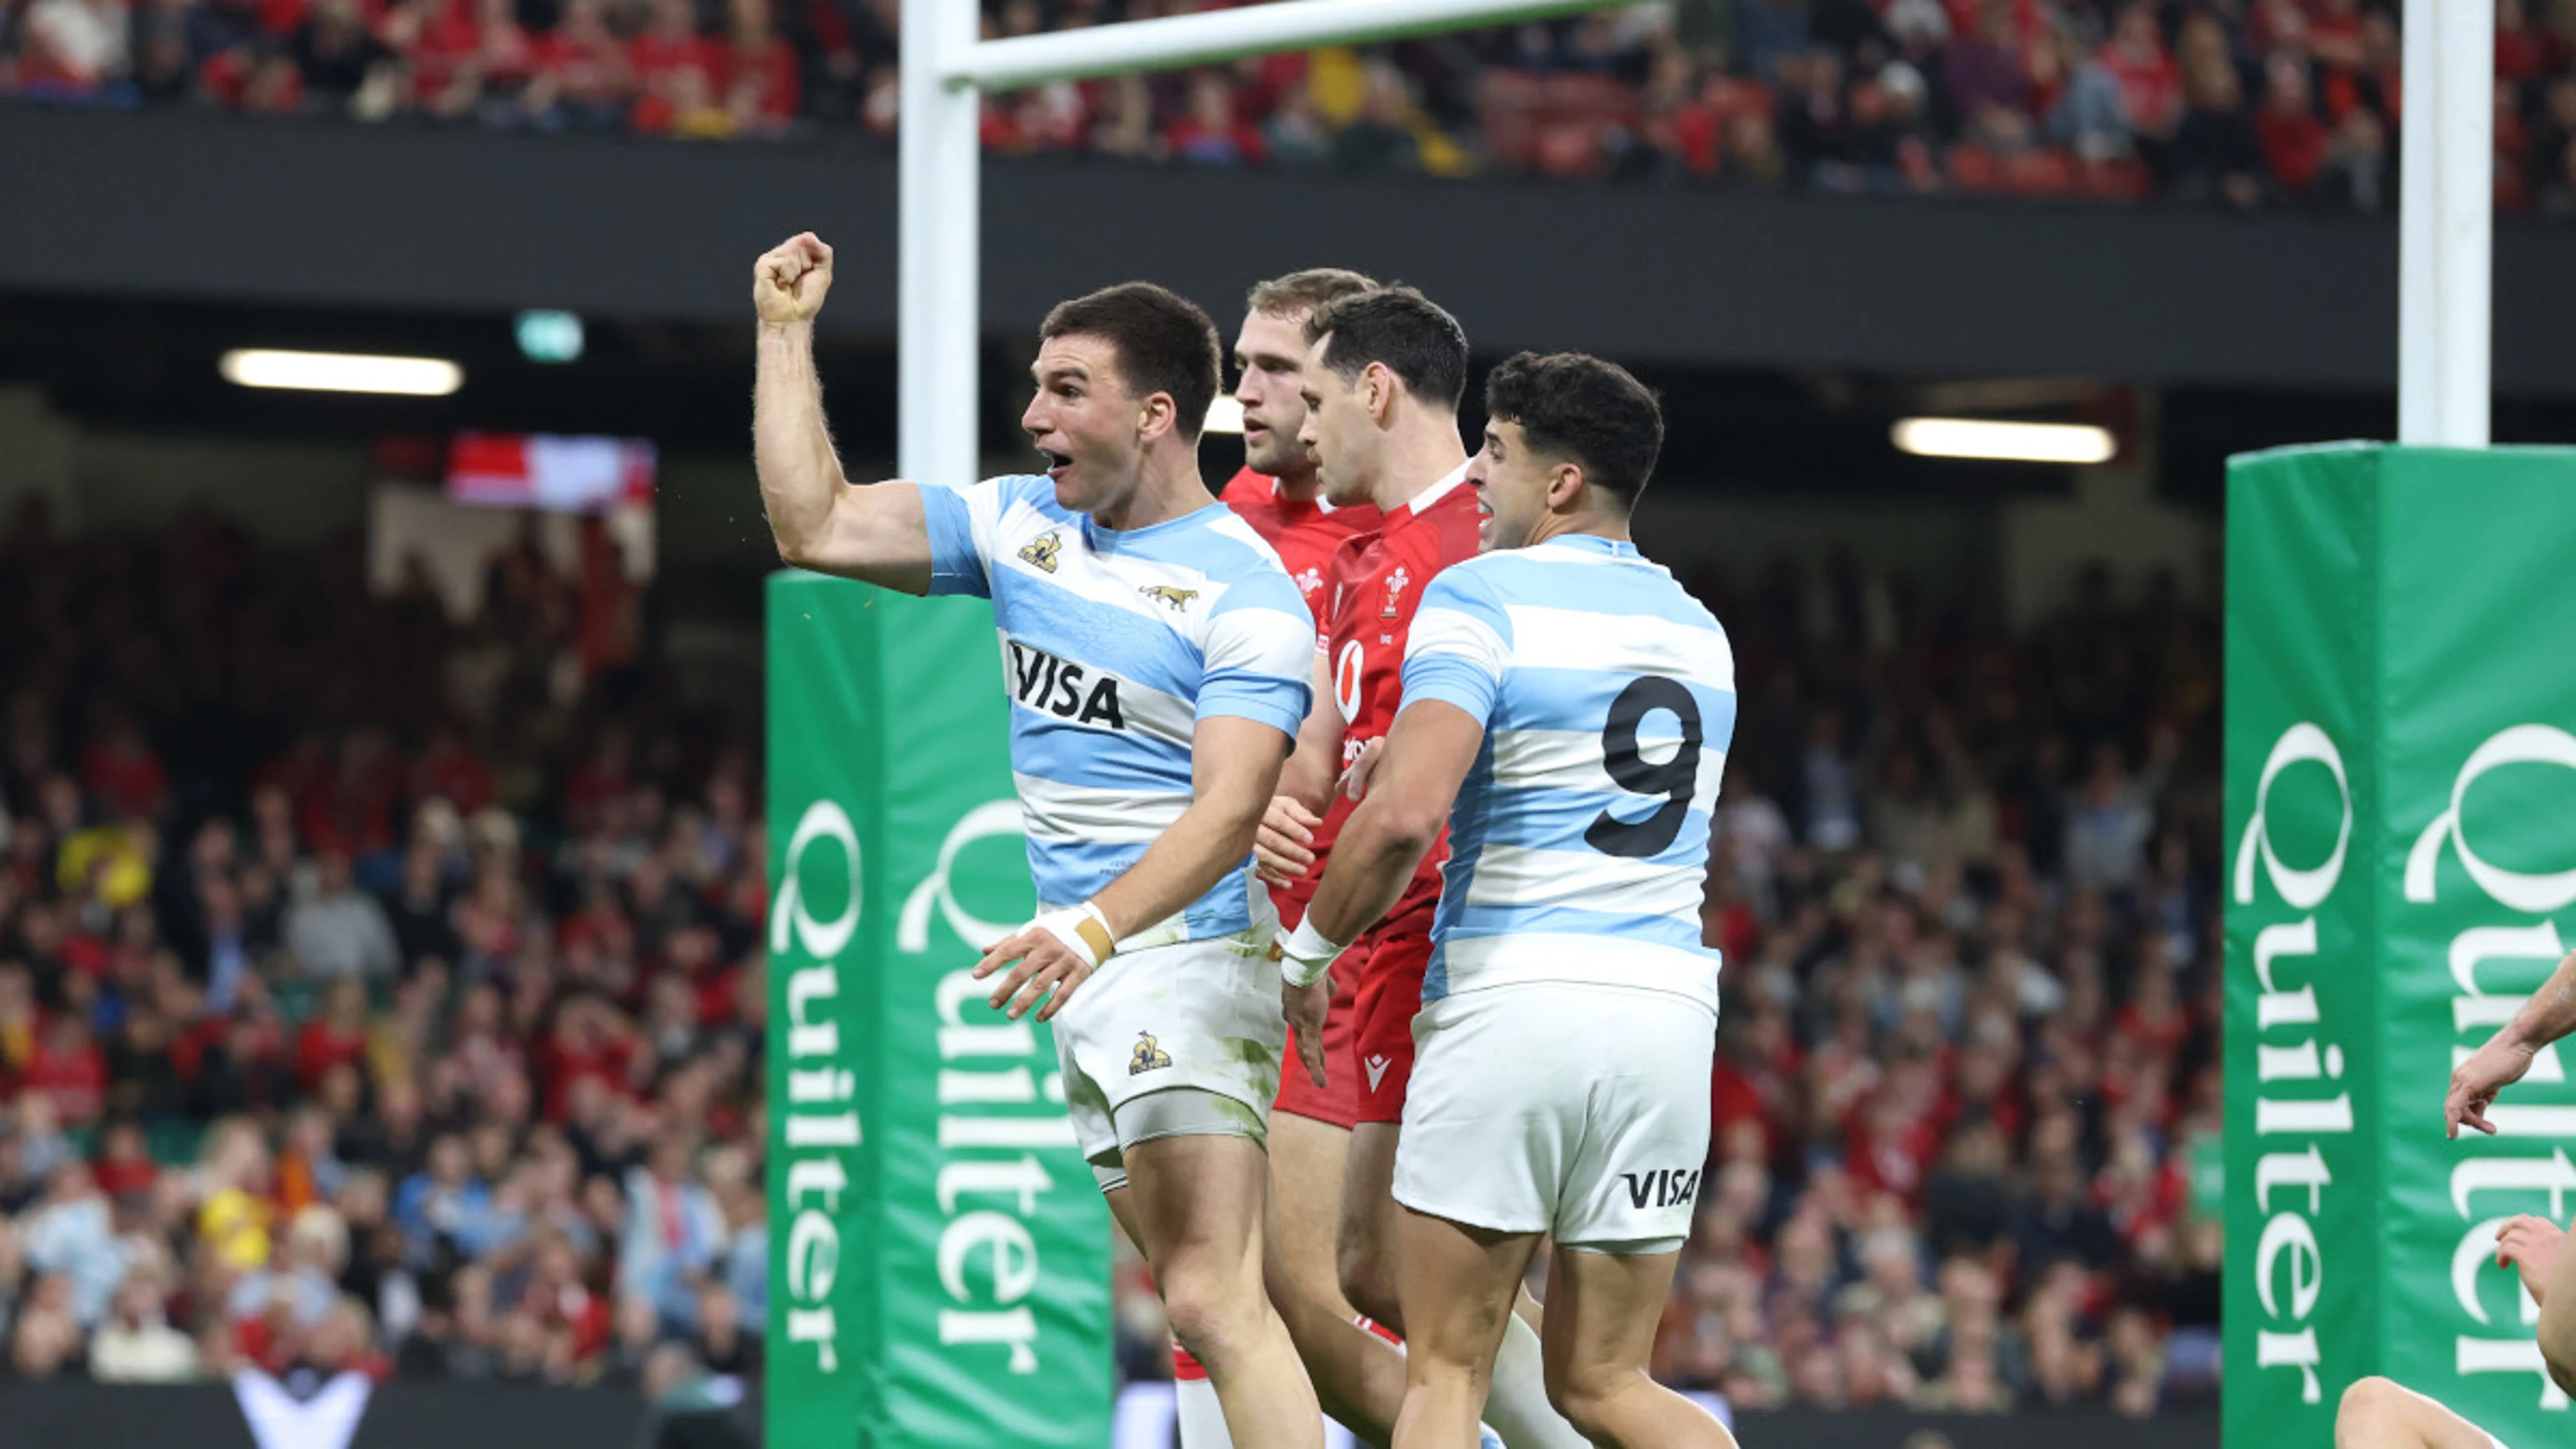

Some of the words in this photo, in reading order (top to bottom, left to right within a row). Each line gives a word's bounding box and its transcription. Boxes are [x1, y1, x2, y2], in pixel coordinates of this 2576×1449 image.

[1008, 640, 1125, 730] VISA
[1584, 676, 1703, 858] 9
[770, 798, 864, 1374] Quilter
[2233, 721, 2355, 1405] Quilter
[1619, 1169, 1700, 1210] VISA
